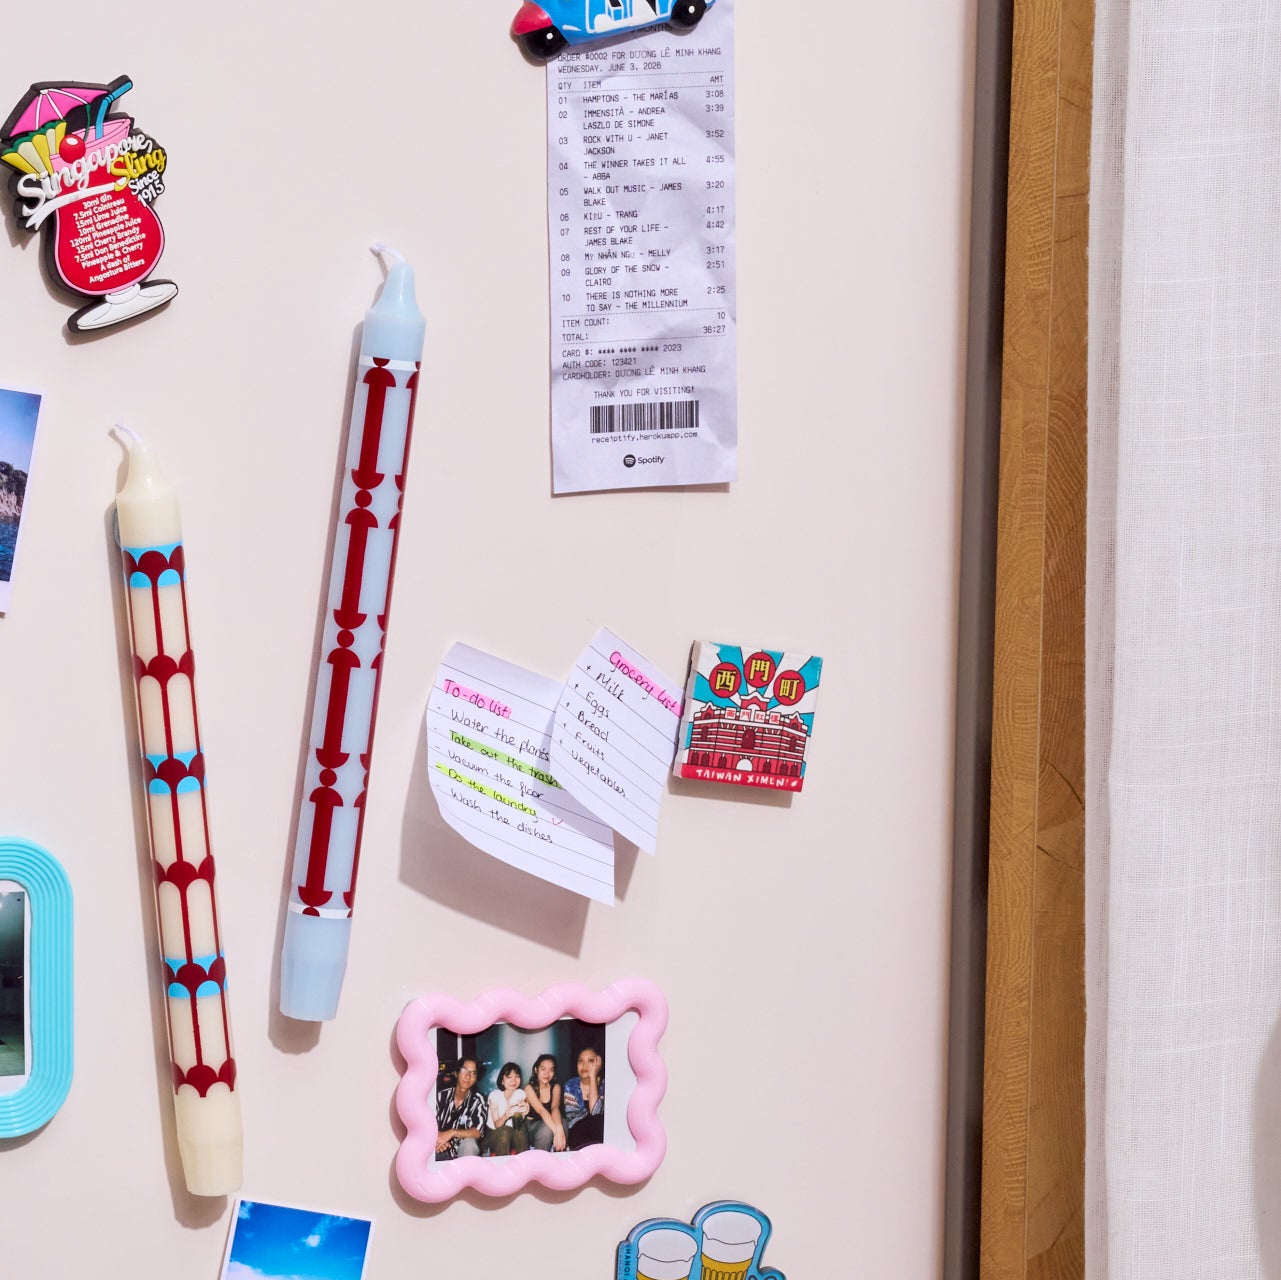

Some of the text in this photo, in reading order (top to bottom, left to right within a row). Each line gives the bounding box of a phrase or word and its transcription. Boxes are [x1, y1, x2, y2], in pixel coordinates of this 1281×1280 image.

[612, 51, 625, 59] FOR
[675, 49, 693, 57] MINH
[698, 48, 721, 56] KHANG
[608, 63, 625, 71] JUNE
[643, 62, 661, 70] 2026
[558, 75, 723, 90] QTY ITEM AMT
[583, 94, 619, 104] HAMPTONS
[638, 107, 665, 115] ANDREA
[583, 119, 654, 130] LASZLO DE SIMONE
[583, 130, 724, 143] ROCK WITH JANET 3:52
[584, 147, 615, 156] JACKSON
[584, 155, 724, 169] THE WINNER TAKES IT ALL 4:55
[17, 134, 153, 216] Singapore
[110, 148, 167, 192] Sling
[592, 172, 610, 180] ABBA
[128, 170, 159, 195] Since
[138, 180, 165, 207] 1915
[584, 183, 682, 195] WALK OUT MUSIC JAMES
[83, 194, 112, 209] 30ml Gin
[584, 198, 606, 206] BLAKE
[76, 206, 127, 228] 15ml Lime Juice
[78, 214, 129, 236] 10ml Grenadine
[616, 210, 638, 218] TRANG
[70, 217, 142, 247] 120ml Pineapple Juice
[76, 227, 140, 253] 15ml Cherry Brandy
[81, 254, 114, 269] Pineapple
[122, 242, 143, 254] Cherry
[107, 259, 122, 268] dash
[123, 255, 130, 264] of
[89, 259, 145, 283] Angostura Bitters
[586, 288, 678, 300] THERE IS NOTHING MORE
[562, 333, 588, 341] TOTAL:
[594, 386, 695, 399] THANK YOU FOR VISITING!
[638, 455, 665, 465] Spotify
[609, 651, 654, 700] Grocery
[596, 672, 624, 702] Milk
[586, 692, 609, 718] Eggs
[451, 709, 550, 763] Water the plants
[578, 710, 609, 742] Bread
[575, 731, 604, 761] Fruits
[450, 729, 560, 788] Take out the trash
[494, 773, 512, 786] the
[520, 781, 544, 800] floor
[696, 769, 742, 782] TAIWAN
[449, 769, 539, 823] Do the laundry
[451, 789, 552, 843] Wash the dishes
[624, 1248, 632, 1276] HANOI
